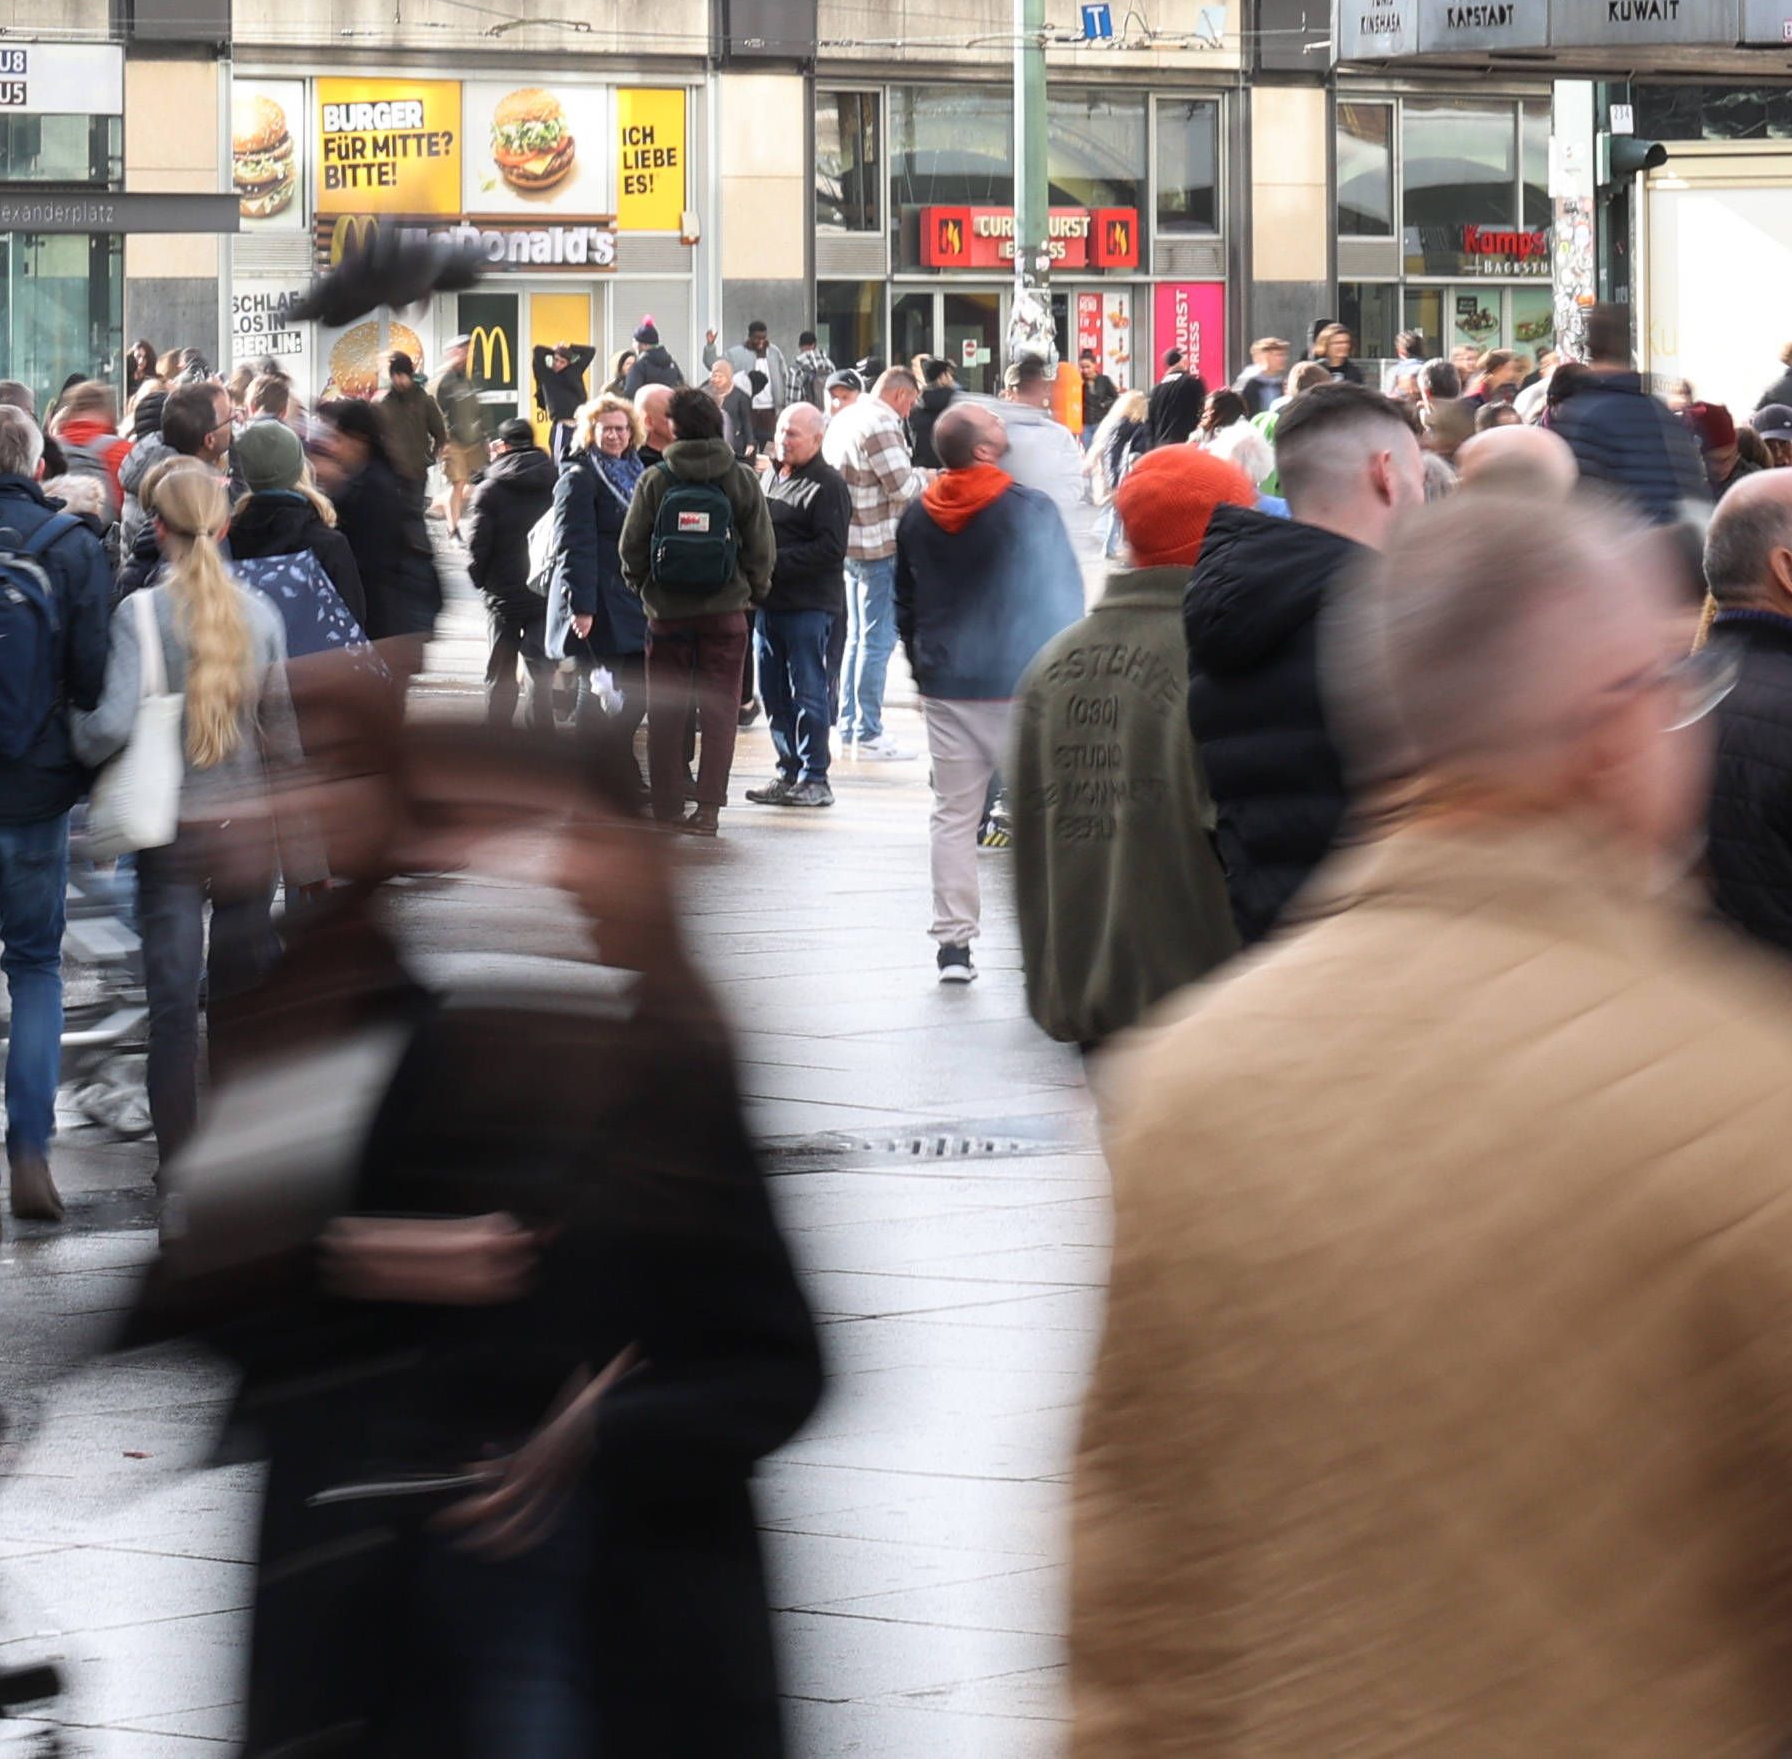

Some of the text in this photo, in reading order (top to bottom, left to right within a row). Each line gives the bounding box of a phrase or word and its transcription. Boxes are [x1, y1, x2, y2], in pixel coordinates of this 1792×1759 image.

[1087, 6, 1104, 36] T
[1447, 4, 1514, 29] KAPSTADT
[1608, 0, 1680, 22] KUWAIT
[1360, 12, 1401, 35] KINSHASA
[323, 100, 423, 132] BURGER
[372, 131, 454, 159] MITTE?
[622, 126, 655, 147] ICH
[623, 147, 678, 170] LIEBE
[324, 163, 398, 190] BITTE!
[624, 174, 654, 196] ES!
[233, 312, 286, 334] OS IN
